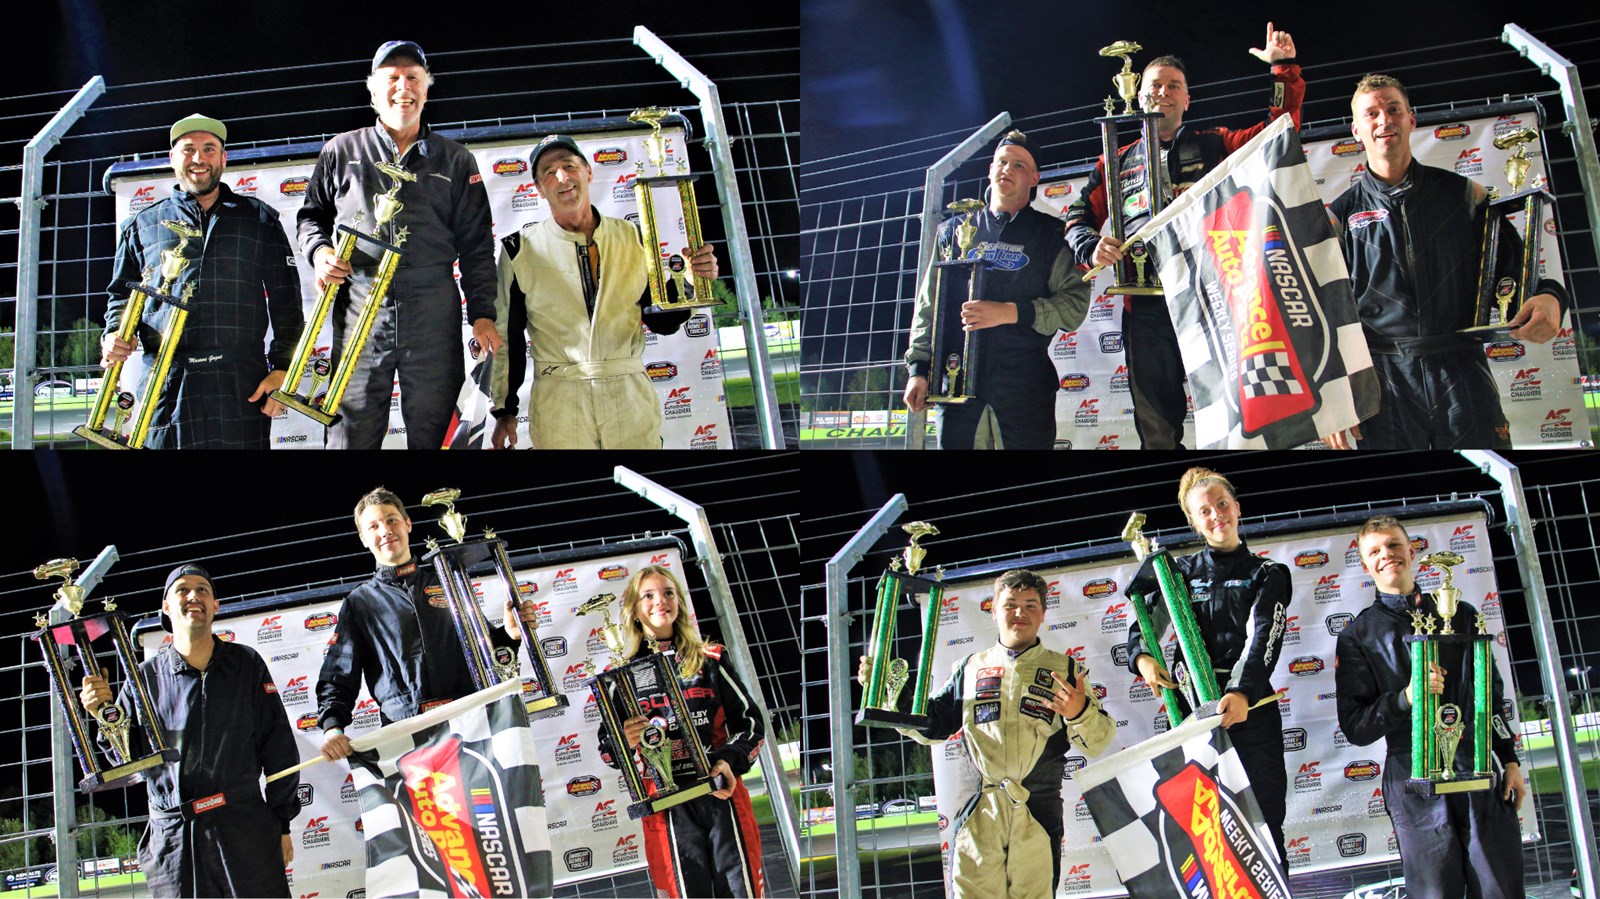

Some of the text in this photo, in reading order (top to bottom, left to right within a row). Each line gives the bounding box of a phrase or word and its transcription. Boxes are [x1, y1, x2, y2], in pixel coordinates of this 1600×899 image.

[1454, 148, 1482, 166] AC
[1208, 230, 1242, 284] Auto
[1232, 229, 1273, 342] Advance
[1265, 249, 1314, 328] NASCAR
[1091, 294, 1115, 309] AC
[1055, 332, 1078, 347] AC
[1205, 280, 1238, 382] WEEKLY SERIES
[1510, 368, 1541, 387] AC
[664, 387, 692, 405] AC
[1511, 390, 1541, 398] CHAUDIERE
[1075, 399, 1099, 414] AC
[1541, 409, 1573, 427] AC
[690, 424, 718, 442] AC
[1450, 525, 1475, 542] AC
[553, 568, 576, 584] AC
[1315, 574, 1340, 591] AC
[1101, 603, 1127, 621] AC
[258, 616, 282, 632] AC
[1055, 621, 1077, 630] NASCAR
[563, 664, 587, 680] AC
[283, 676, 308, 694] AC
[352, 699, 380, 716] AC
[555, 734, 580, 752] AC
[1294, 762, 1322, 780] AC
[408, 765, 436, 827] Auto
[592, 800, 617, 819] AC
[1319, 805, 1342, 814] NASCAR
[302, 816, 330, 835] AC
[303, 837, 330, 845] CHAUDIERE
[613, 834, 638, 854] AC
[1287, 837, 1311, 854] AC
[475, 813, 513, 896] NASCAR
[327, 860, 351, 868] NASCAR
[1065, 864, 1091, 881] AC
